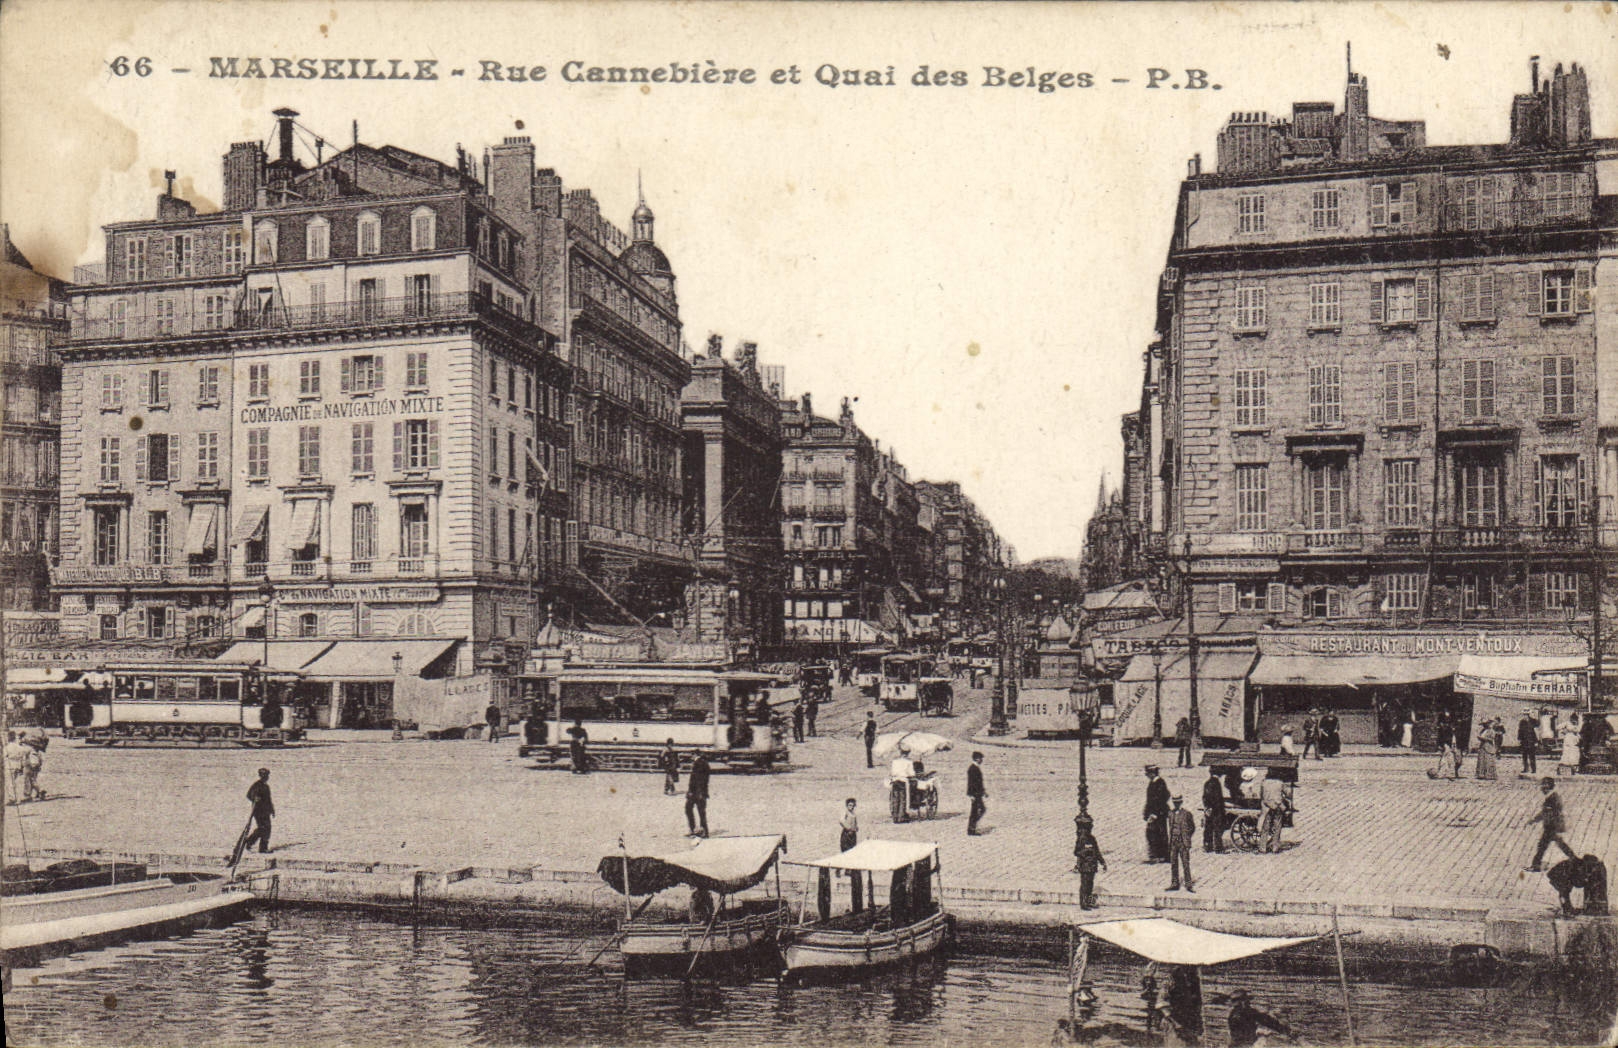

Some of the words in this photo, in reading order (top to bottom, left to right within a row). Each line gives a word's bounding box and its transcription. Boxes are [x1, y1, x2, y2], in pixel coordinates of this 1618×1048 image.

[241, 405, 311, 424] COMPAGNIE
[323, 399, 396, 419] NAVIGATION
[400, 397, 444, 414] MIXTE
[300, 588, 356, 600] NAVIGATION
[359, 588, 390, 599] MIXTE
[1311, 637, 1398, 652] RESTAURANT
[1415, 637, 1522, 652] MONT-VENTOUX
[1530, 683, 1579, 694] FERRARY
